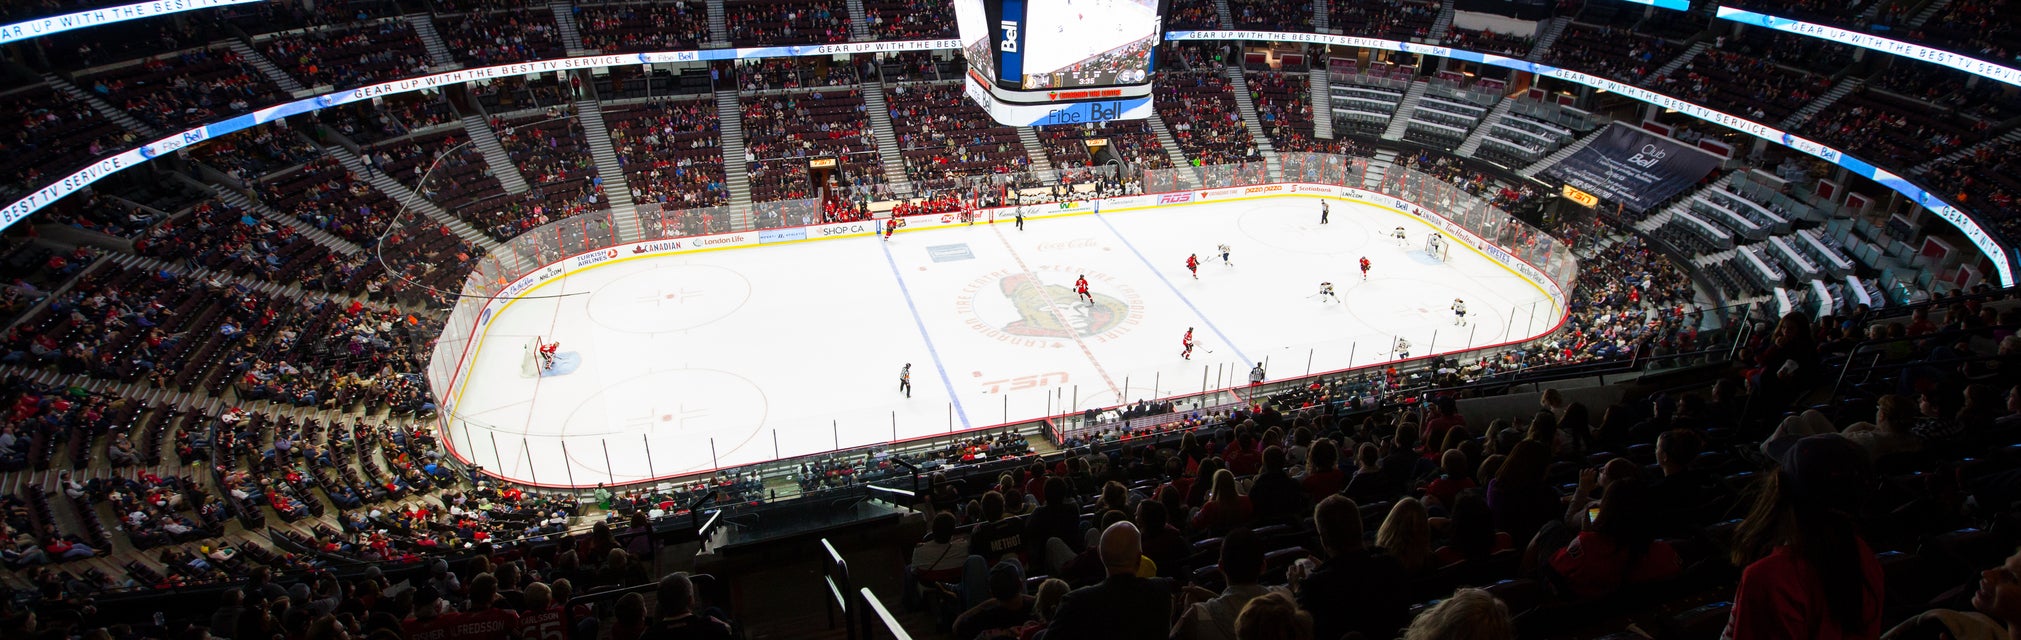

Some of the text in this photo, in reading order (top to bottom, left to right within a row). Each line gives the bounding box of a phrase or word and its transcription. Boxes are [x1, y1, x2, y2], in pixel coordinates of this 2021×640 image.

[33, 20, 52, 33] UP
[60, 12, 105, 28] WITH
[112, 5, 144, 19] THE
[1001, 21, 1018, 53] Bell
[1190, 31, 1216, 39] GEAR
[1221, 31, 1234, 39] UP
[1237, 31, 1263, 39] WITH
[1268, 32, 1286, 40] THE
[1292, 33, 1317, 41] BEST
[1322, 35, 1336, 43] TV
[818, 39, 963, 54] GEAR UP WITH THE BEST
[1432, 47, 1446, 56] Bell
[1791, 22, 1823, 35] GEAR
[1830, 28, 1846, 40] UP
[1851, 34, 1882, 48] WITH
[1888, 41, 1912, 55] THE
[1918, 48, 1953, 63] BEST
[1957, 57, 1972, 69] TV
[678, 52, 694, 61] Bell
[354, 85, 393, 99] GEAR
[401, 80, 418, 91] UP
[426, 72, 462, 87] WITH
[468, 68, 494, 79] THE
[501, 62, 536, 75] BEST
[542, 60, 559, 70] TV
[1556, 69, 1585, 83] GEAR
[1590, 76, 1605, 87] UP
[1608, 81, 1635, 96] WITH
[1639, 90, 1659, 103] THE
[1663, 97, 1692, 113] BEST
[1696, 107, 1710, 118] TV
[1049, 102, 1121, 123] Fibe Bell
[183, 130, 203, 144] Bell
[1641, 144, 1665, 159] Club
[1820, 146, 1836, 160] Bell
[1627, 153, 1660, 169] Bell
[1567, 188, 1592, 204] TSN
[3, 197, 37, 223] BEST
[41, 186, 59, 202] TV
[1395, 200, 1409, 212] Bell
[1941, 205, 1967, 229] GEAR
[644, 242, 681, 253] CANADIAN
[704, 237, 730, 246] London
[577, 251, 607, 261] TURKISH
[578, 256, 608, 267] AIRLINES
[982, 371, 1069, 394] TSN
